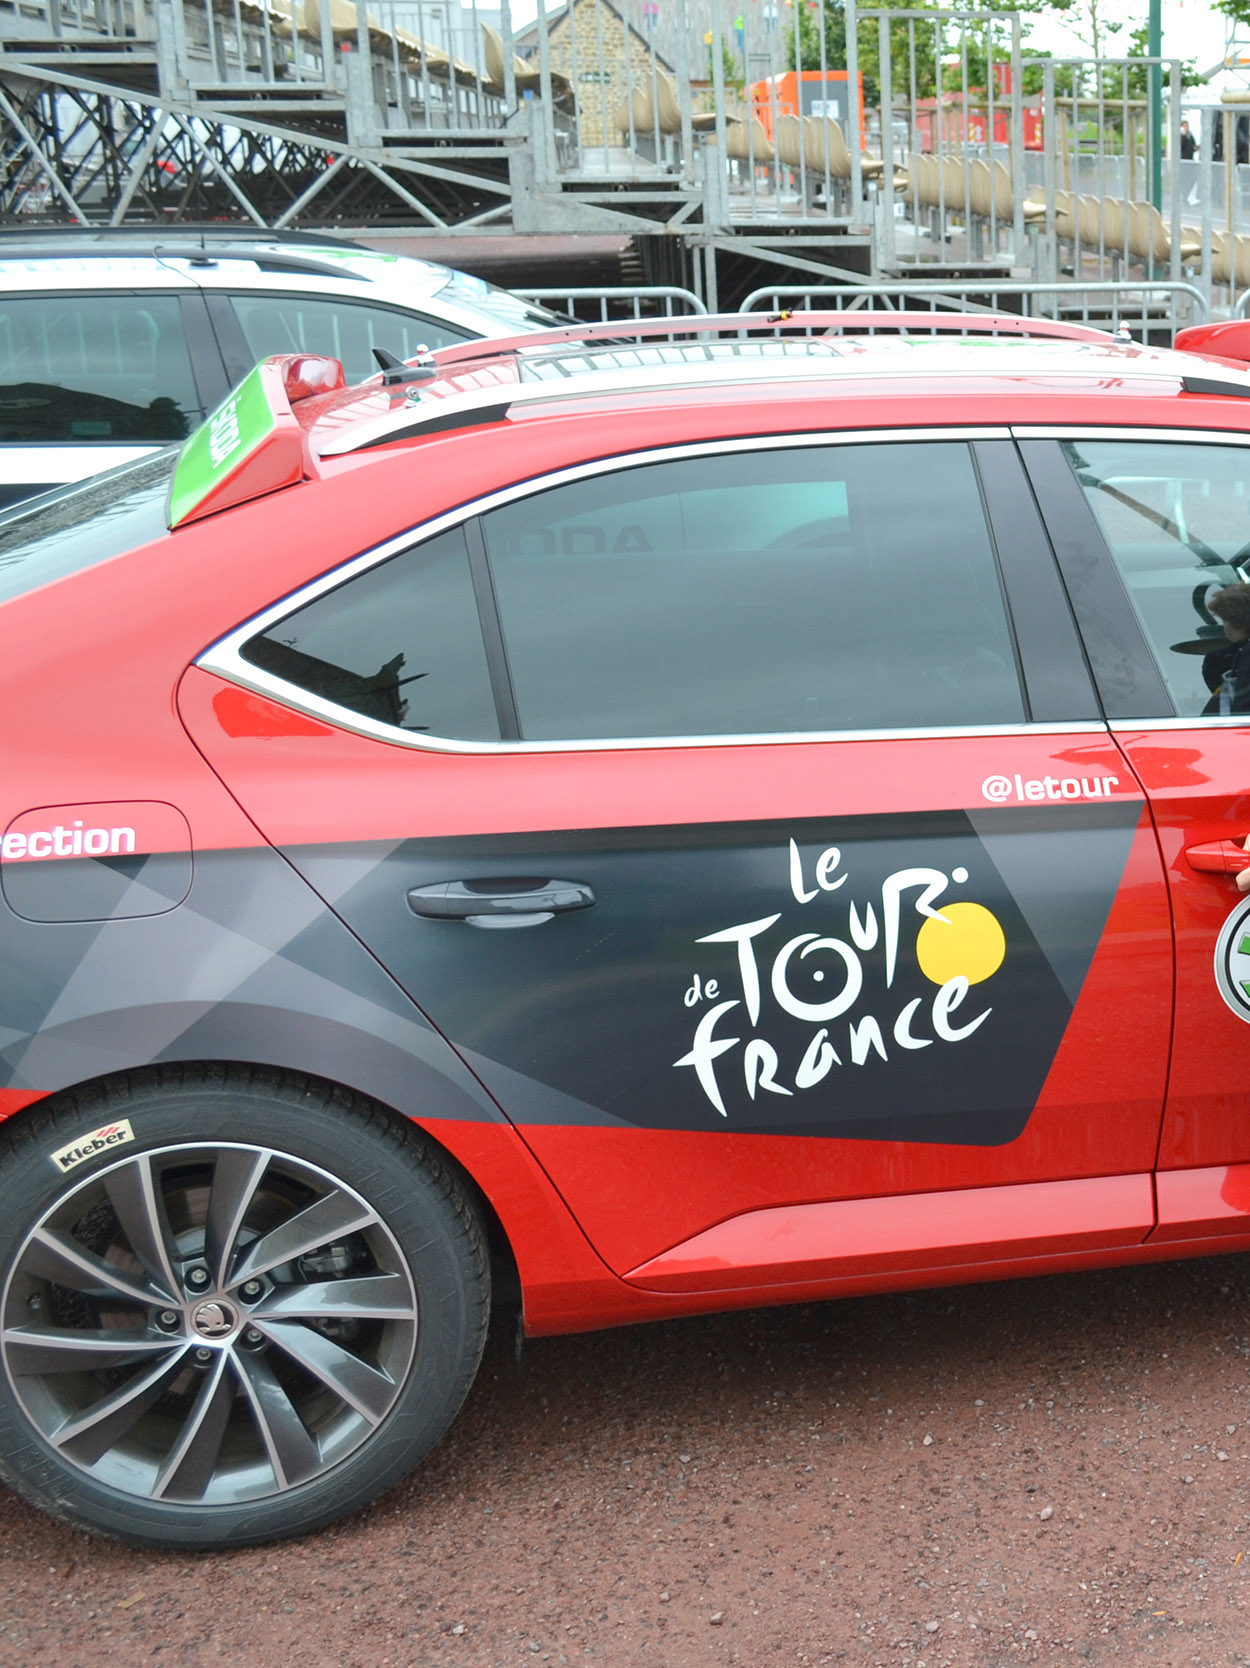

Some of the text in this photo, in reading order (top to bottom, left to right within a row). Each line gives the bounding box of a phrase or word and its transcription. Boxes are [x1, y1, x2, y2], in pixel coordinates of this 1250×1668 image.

[981, 774, 1119, 802] @letour
[0, 820, 136, 859] ection
[684, 973, 720, 1008] de
[59, 1129, 126, 1168] Kleber
